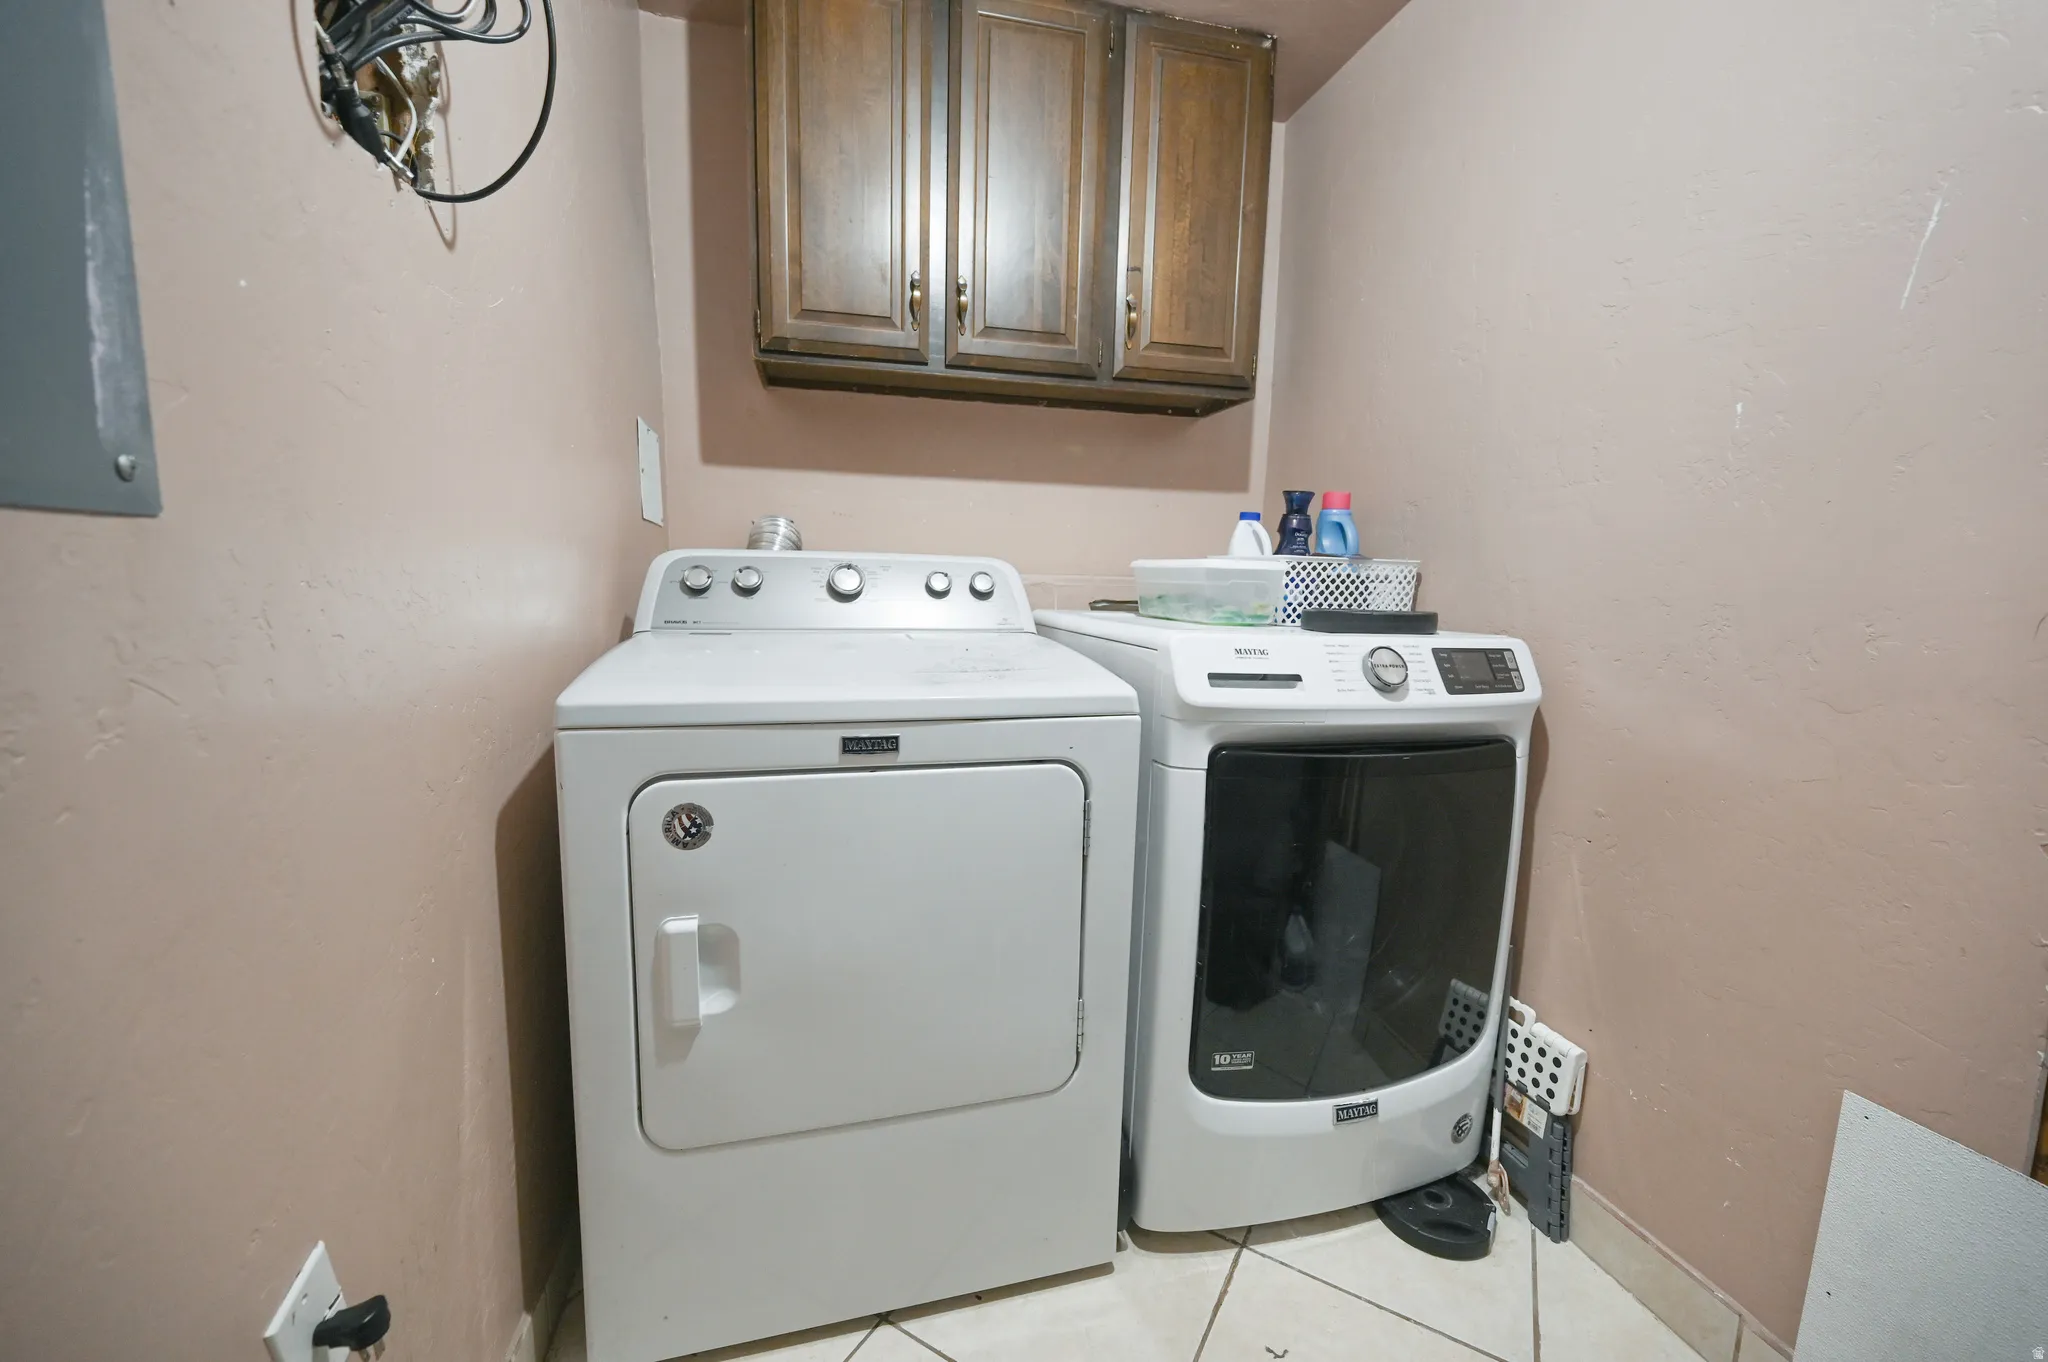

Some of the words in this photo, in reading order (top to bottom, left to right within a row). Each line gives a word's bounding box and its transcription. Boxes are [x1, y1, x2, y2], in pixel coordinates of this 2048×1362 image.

[1234, 648, 1269, 656] MAYTAG
[845, 739, 897, 751] MAYTAG
[1214, 1054, 1231, 1065] 10
[1337, 1104, 1377, 1121] MAYTAG
